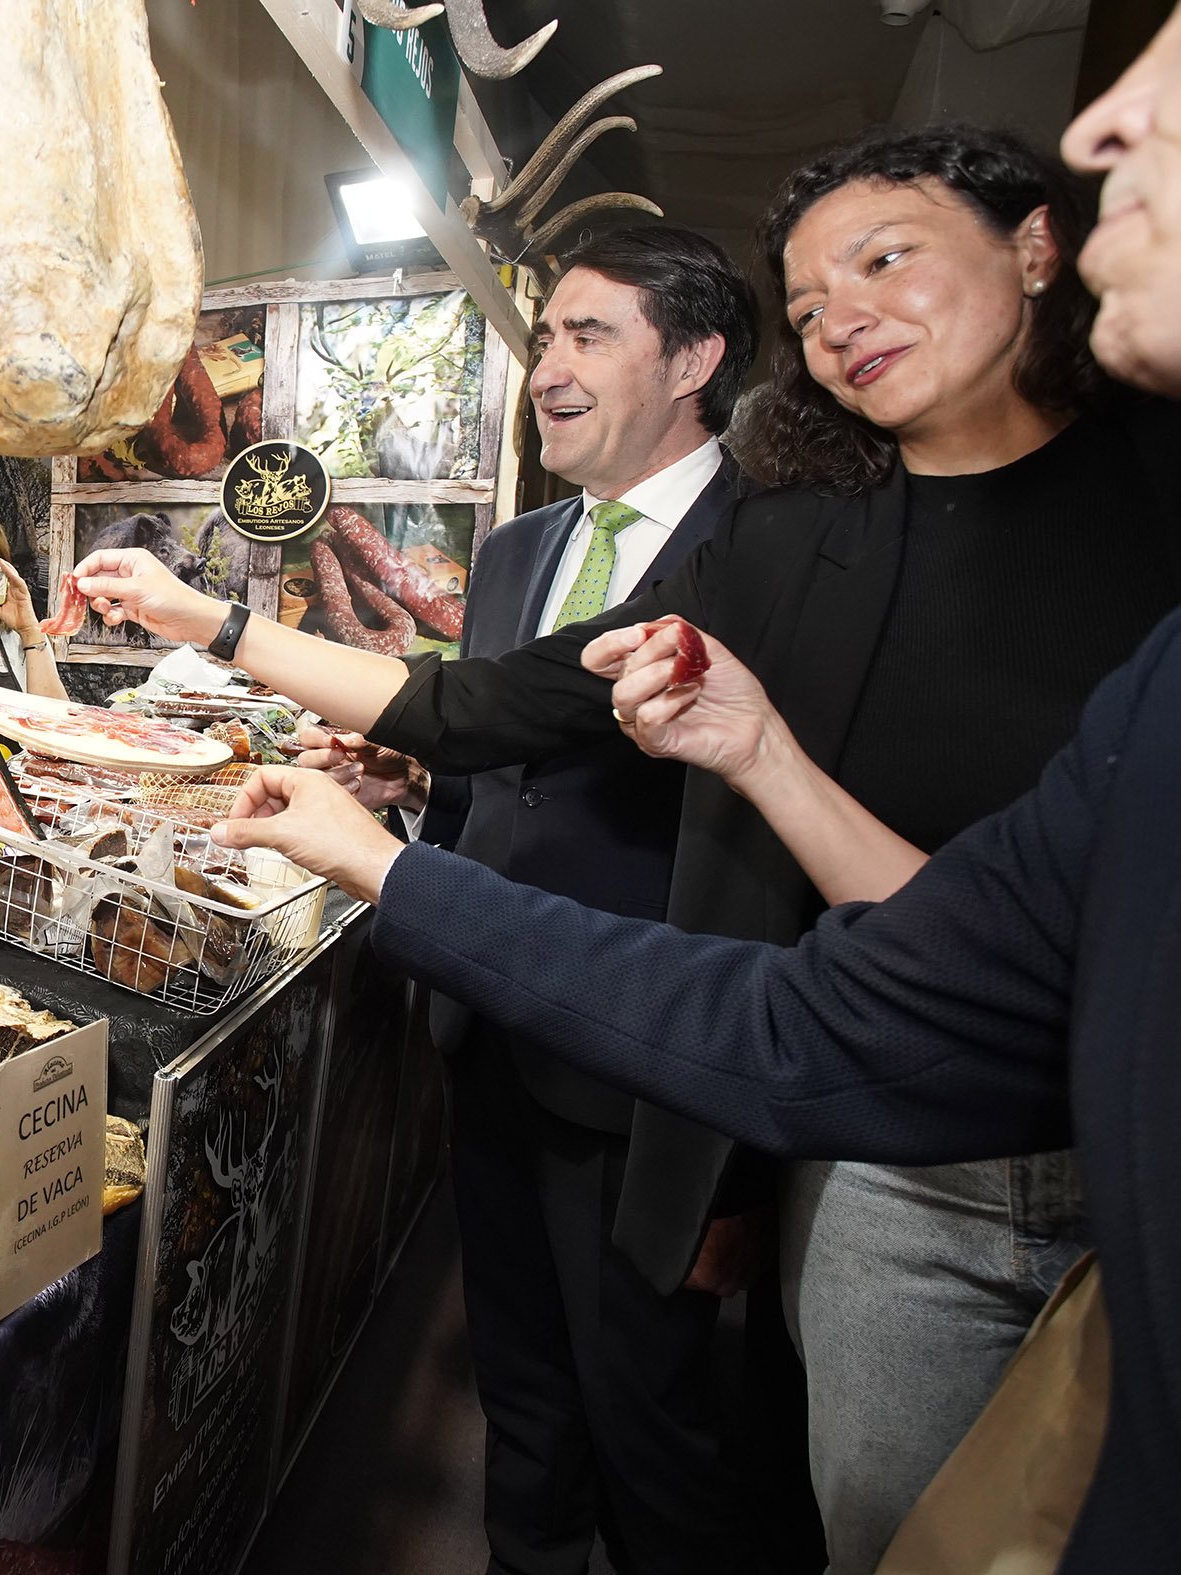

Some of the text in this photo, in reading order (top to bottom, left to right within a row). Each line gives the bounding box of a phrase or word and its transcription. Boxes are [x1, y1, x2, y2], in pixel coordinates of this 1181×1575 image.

[405, 27, 434, 99] REJOS
[248, 499, 294, 516] LOS REJOS
[18, 1084, 89, 1141] CECINA
[23, 1131, 83, 1180] RESERVA
[17, 1165, 83, 1223] DE VACA
[13, 1194, 89, 1255] (CECINA I.G.P LEÓN)
[197, 1238, 277, 1396] LOS REJOS
[152, 1382, 233, 1513] EMBUTIDOS
